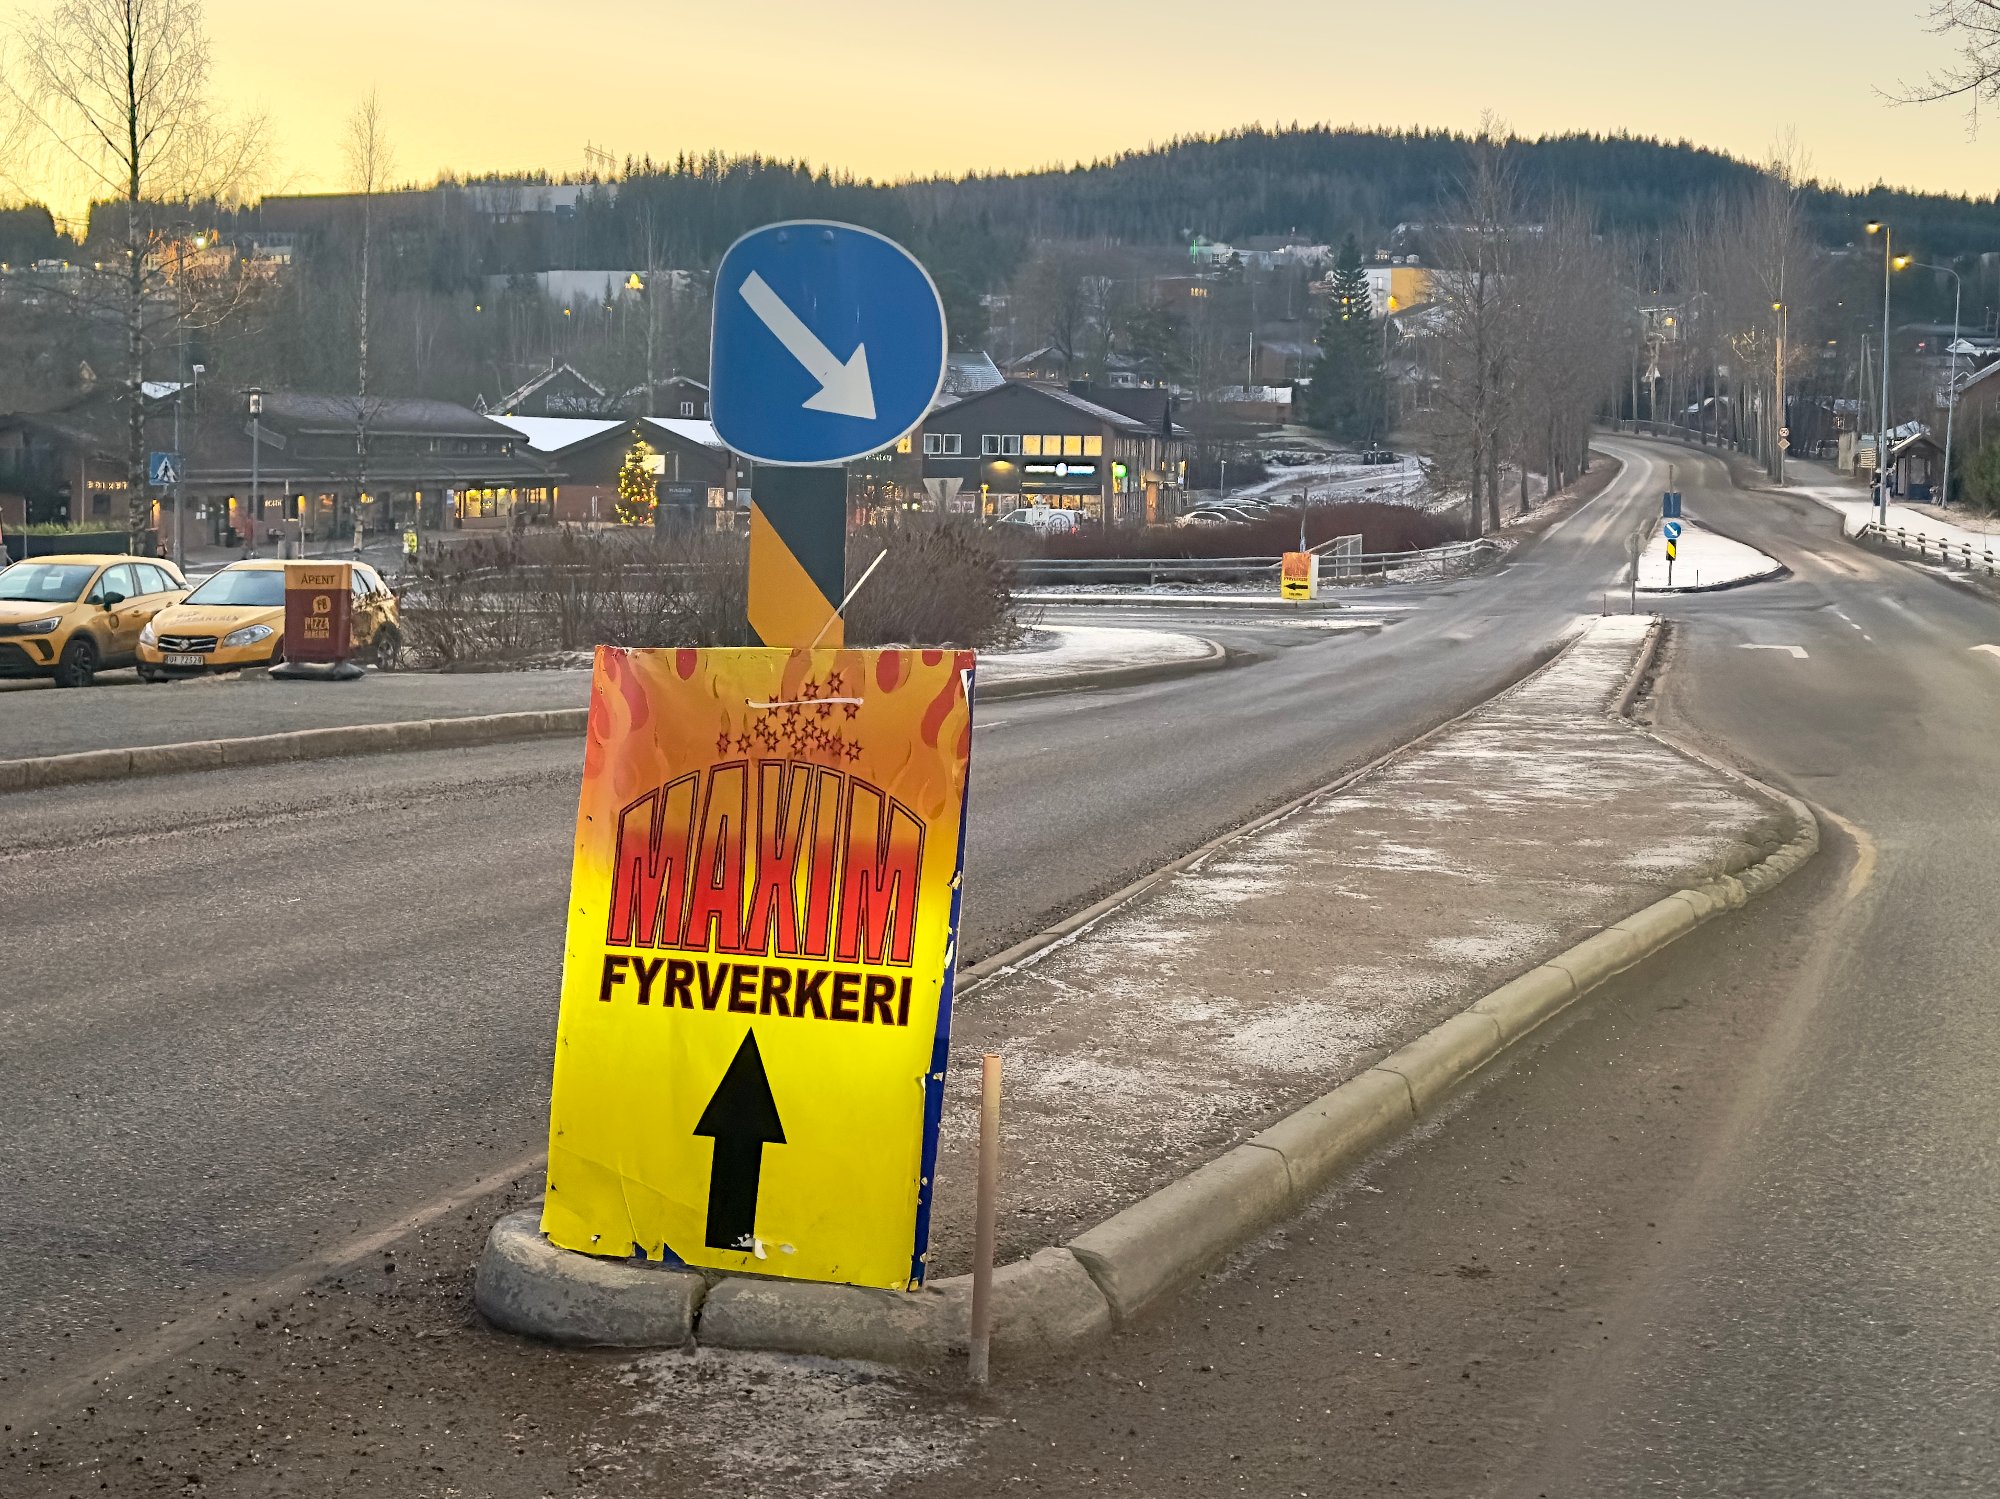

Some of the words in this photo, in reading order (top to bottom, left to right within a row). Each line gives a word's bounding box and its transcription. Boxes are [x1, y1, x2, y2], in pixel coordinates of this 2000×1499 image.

[300, 573, 336, 585] ÅPENT
[304, 617, 330, 630] PIZZA
[606, 758, 926, 968] MAXIM
[598, 953, 913, 1027] FYRVERKERI
